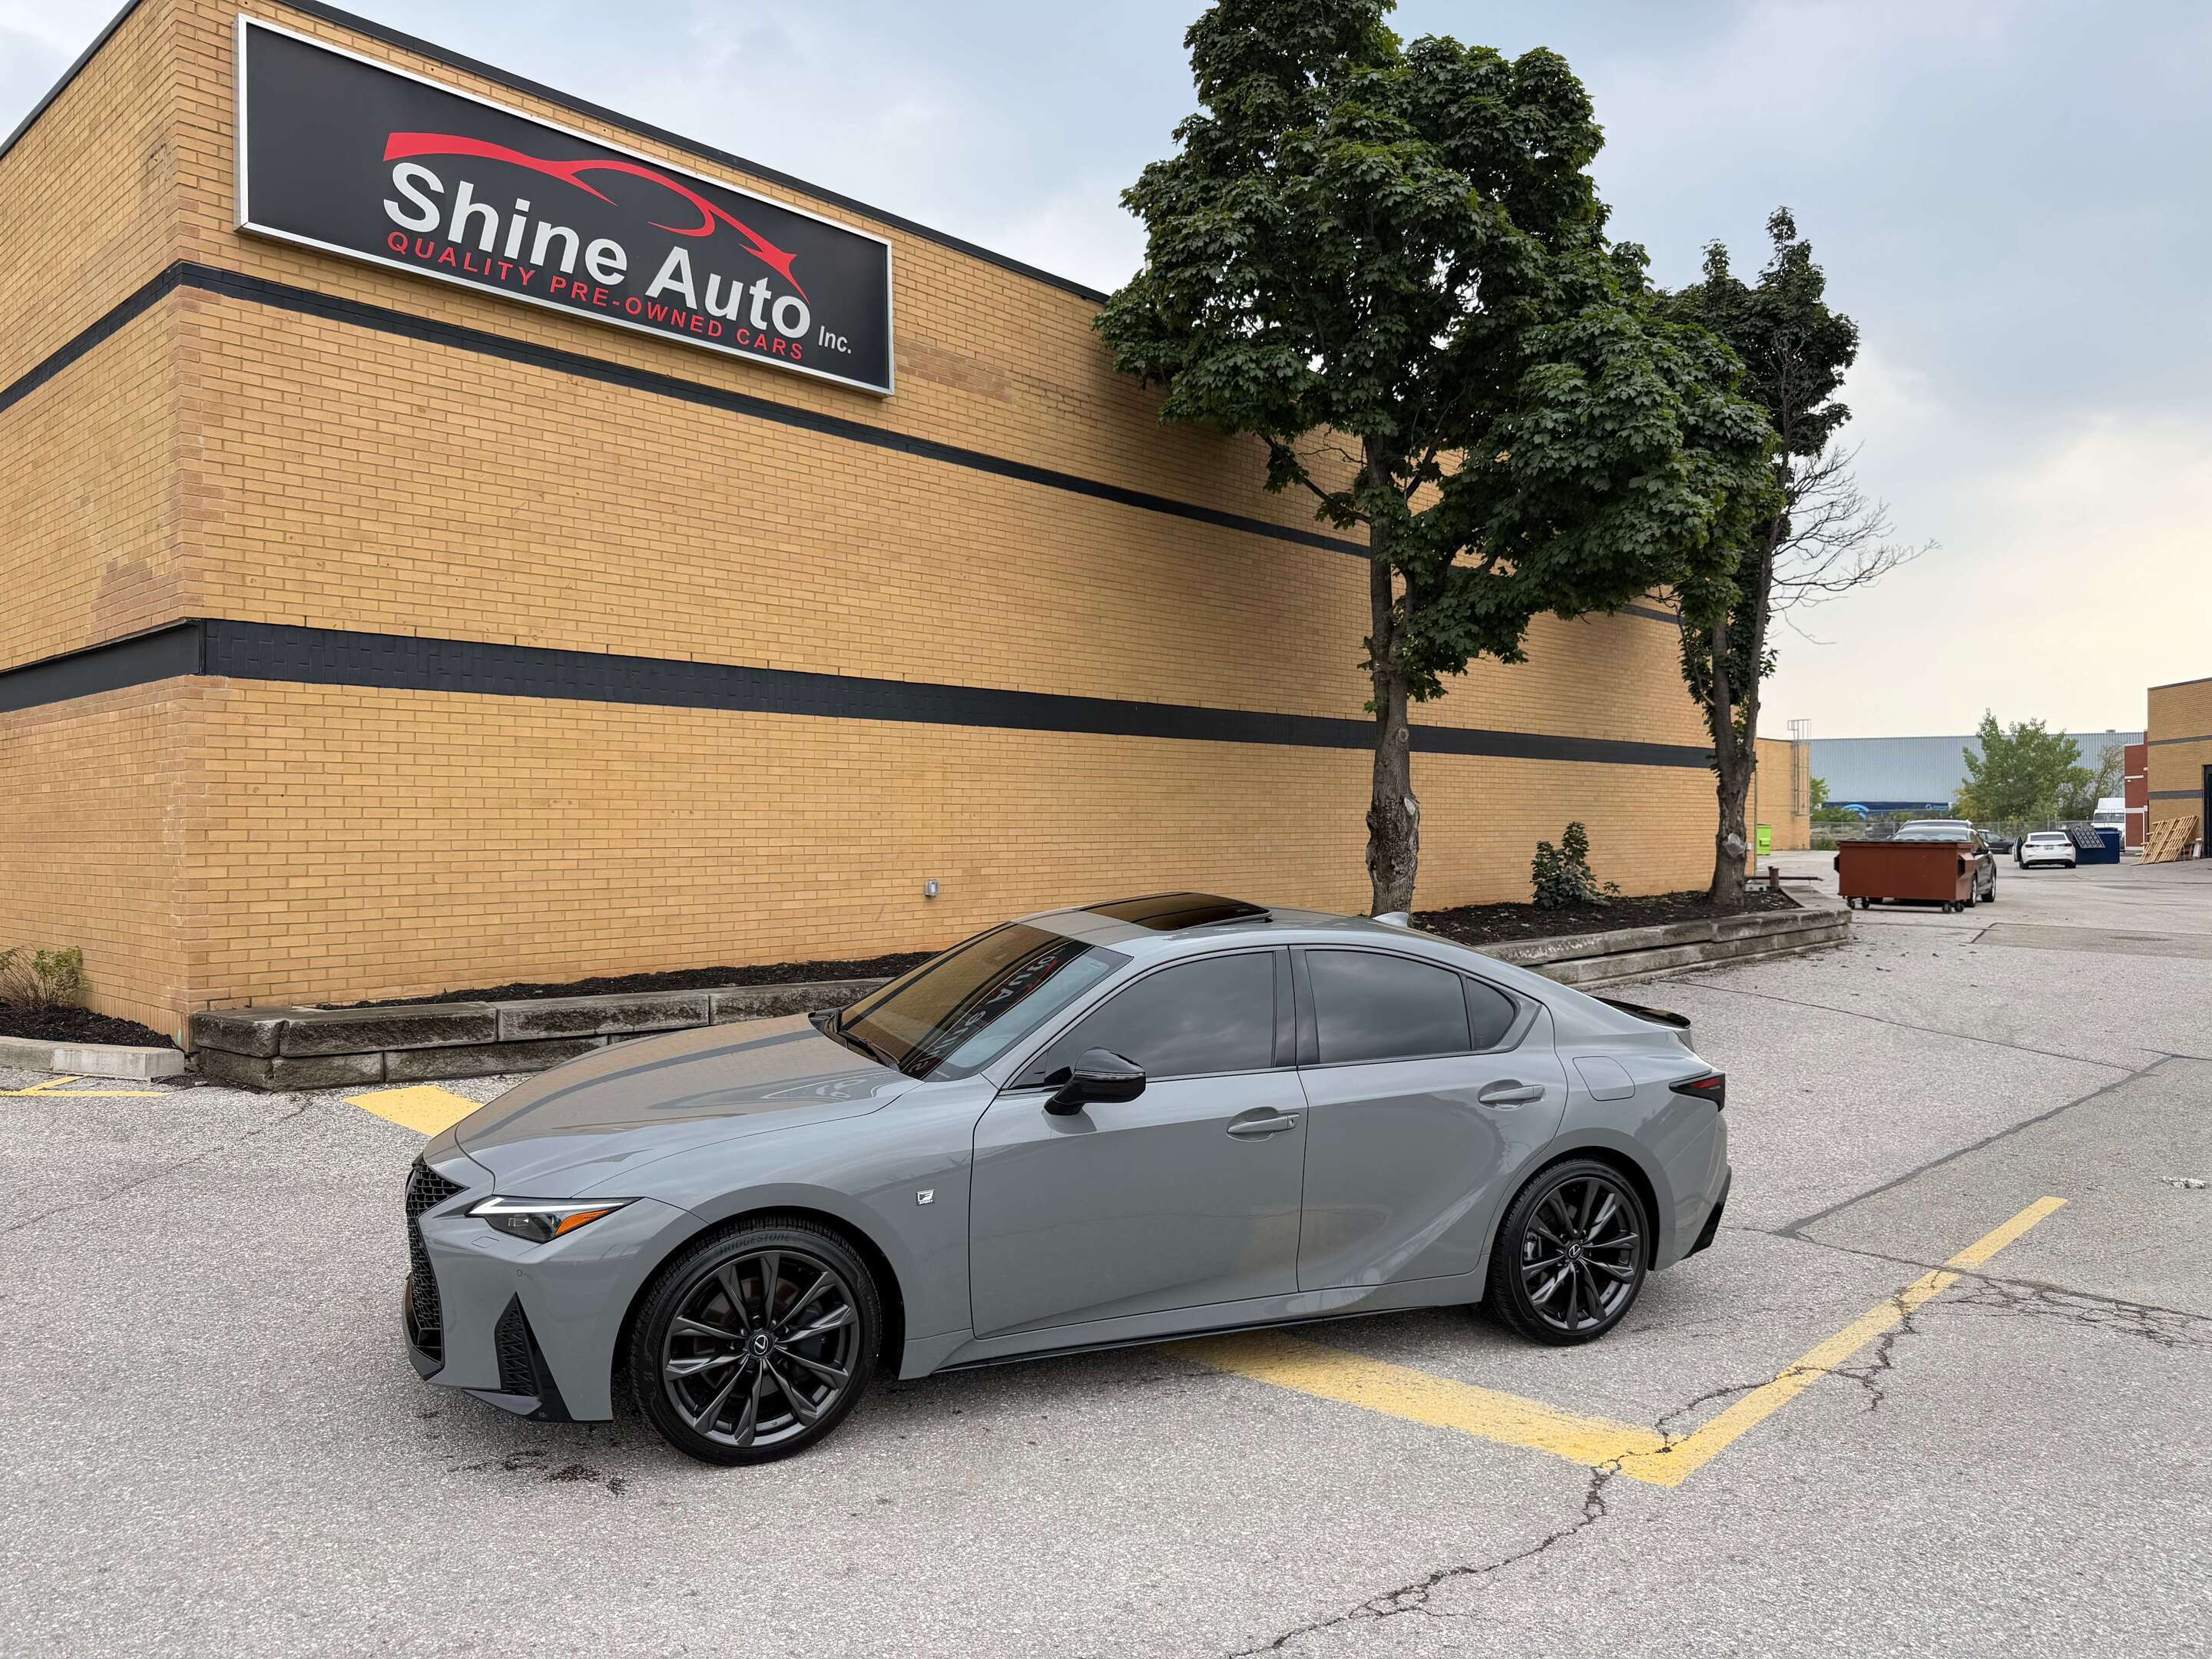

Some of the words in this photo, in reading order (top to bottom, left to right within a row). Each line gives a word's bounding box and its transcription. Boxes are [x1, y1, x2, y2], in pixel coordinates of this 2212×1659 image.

[383, 162, 628, 286] Shine
[644, 245, 811, 339] Auto
[818, 325, 852, 354] Inc.
[386, 231, 535, 286] QUALITY
[550, 276, 723, 337] PRE-OWNED
[737, 328, 803, 360] CARS
